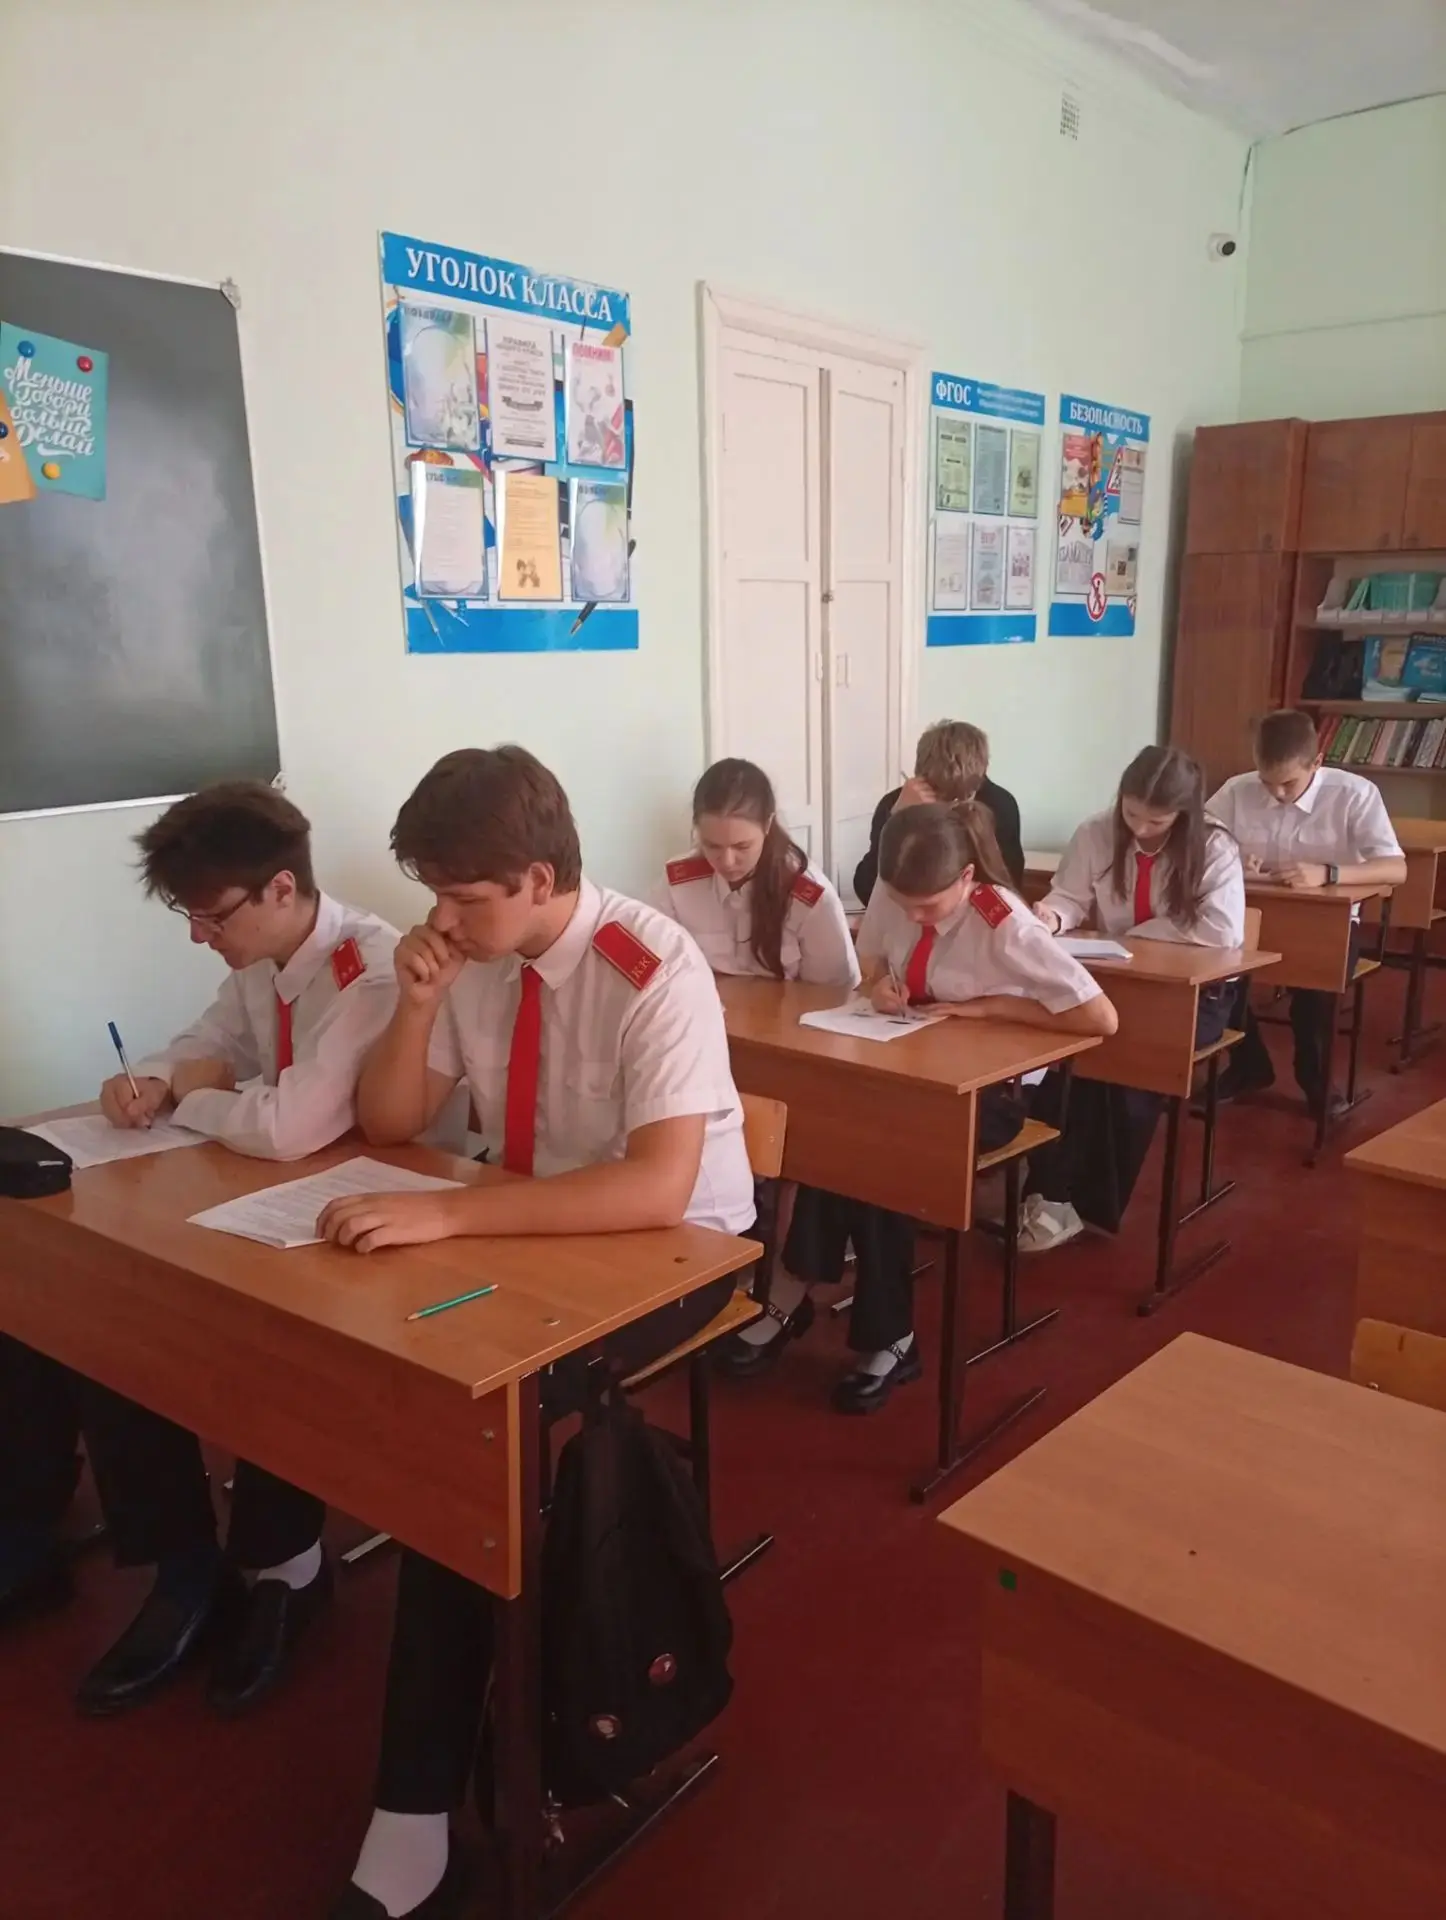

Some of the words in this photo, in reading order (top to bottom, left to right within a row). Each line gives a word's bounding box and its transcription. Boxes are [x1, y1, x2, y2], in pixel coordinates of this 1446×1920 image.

[405, 247, 516, 301] УГОЛОК
[521, 275, 614, 322] КЛАССА
[935, 379, 972, 406] ФГОС
[1069, 402, 1144, 435] БЕЗОПАСНОСТЬ
